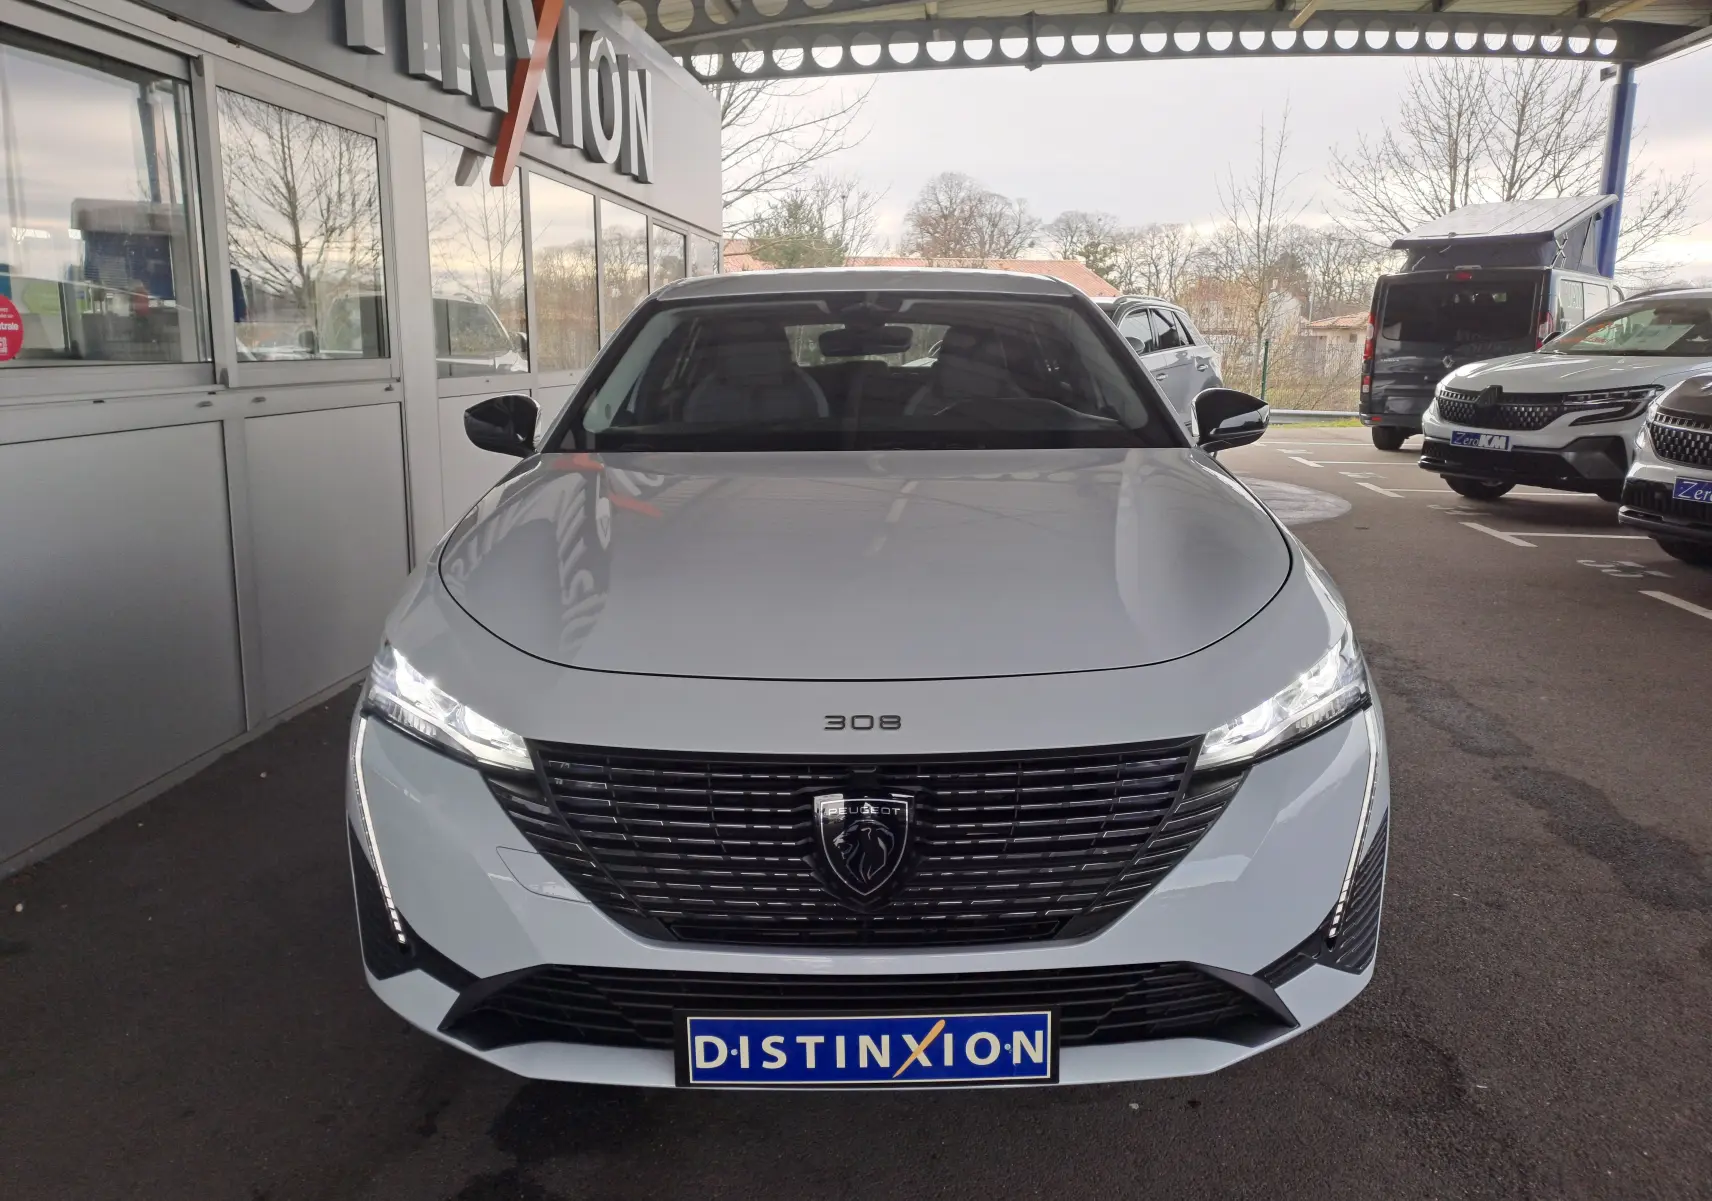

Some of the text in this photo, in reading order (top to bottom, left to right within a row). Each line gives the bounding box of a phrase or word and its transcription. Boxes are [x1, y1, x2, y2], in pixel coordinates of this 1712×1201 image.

[1677, 481, 1712, 501] Zer
[824, 715, 901, 730] 308
[828, 807, 901, 815] PEUGEOT
[694, 1019, 1044, 1078] DISTINXION
